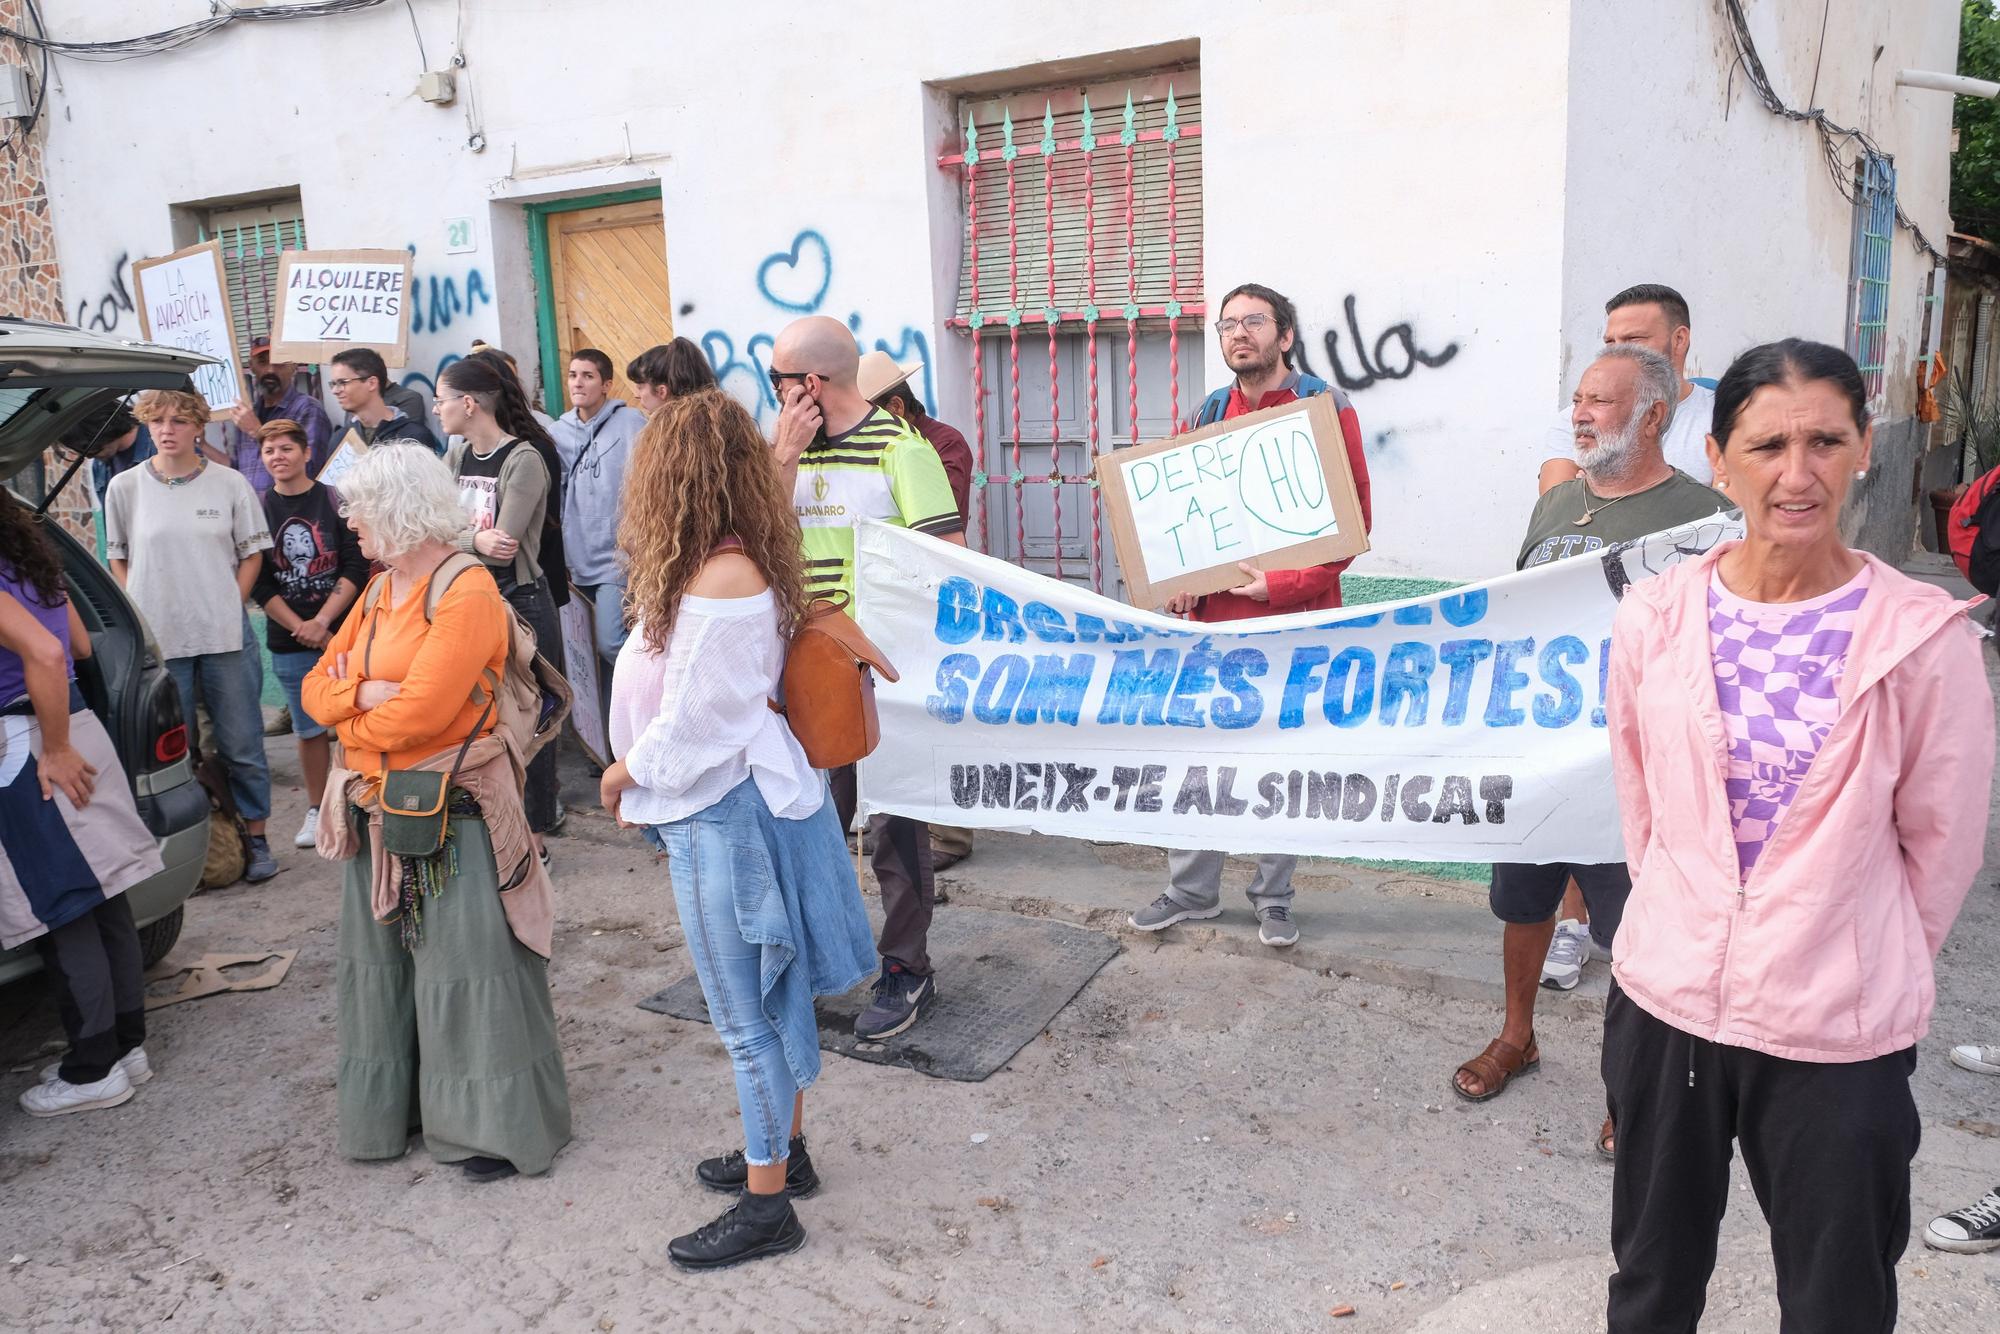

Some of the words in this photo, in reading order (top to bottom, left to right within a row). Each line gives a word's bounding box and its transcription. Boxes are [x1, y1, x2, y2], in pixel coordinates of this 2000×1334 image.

[164, 268, 187, 297] LA
[290, 268, 403, 292] ALQUILERE
[297, 294, 399, 317] SOCIALES
[319, 314, 351, 336] YA
[926, 652, 1096, 727] SOM
[1096, 635, 1270, 730] MÉS
[949, 760, 1167, 813] UNEIX-TE
[1172, 765, 1250, 817] AL
[1250, 769, 1514, 826] SINDICAT
